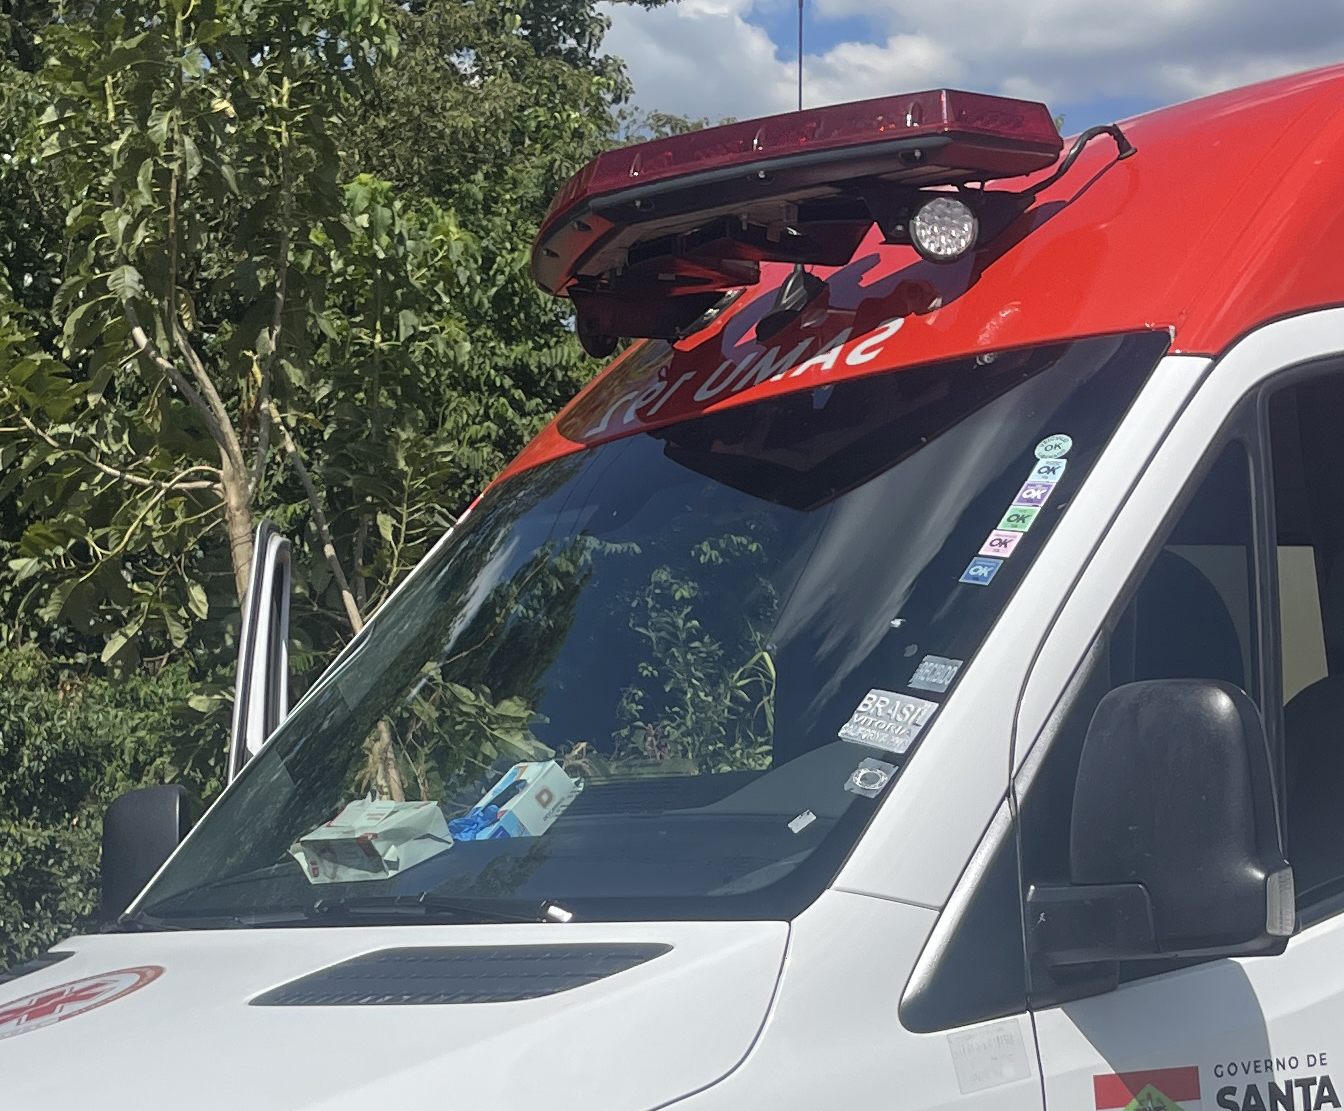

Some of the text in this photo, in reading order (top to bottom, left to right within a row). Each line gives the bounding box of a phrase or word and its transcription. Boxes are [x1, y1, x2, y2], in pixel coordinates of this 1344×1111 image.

[1044, 442, 1062, 452] OK
[1037, 465, 1062, 475] OK
[1021, 488, 1047, 500] OK
[1006, 514, 1032, 524] OK
[989, 538, 1014, 548] OK
[968, 565, 995, 577] OK
[856, 693, 928, 727] BRASIL
[1214, 1052, 1328, 1078] GOVERNO DE
